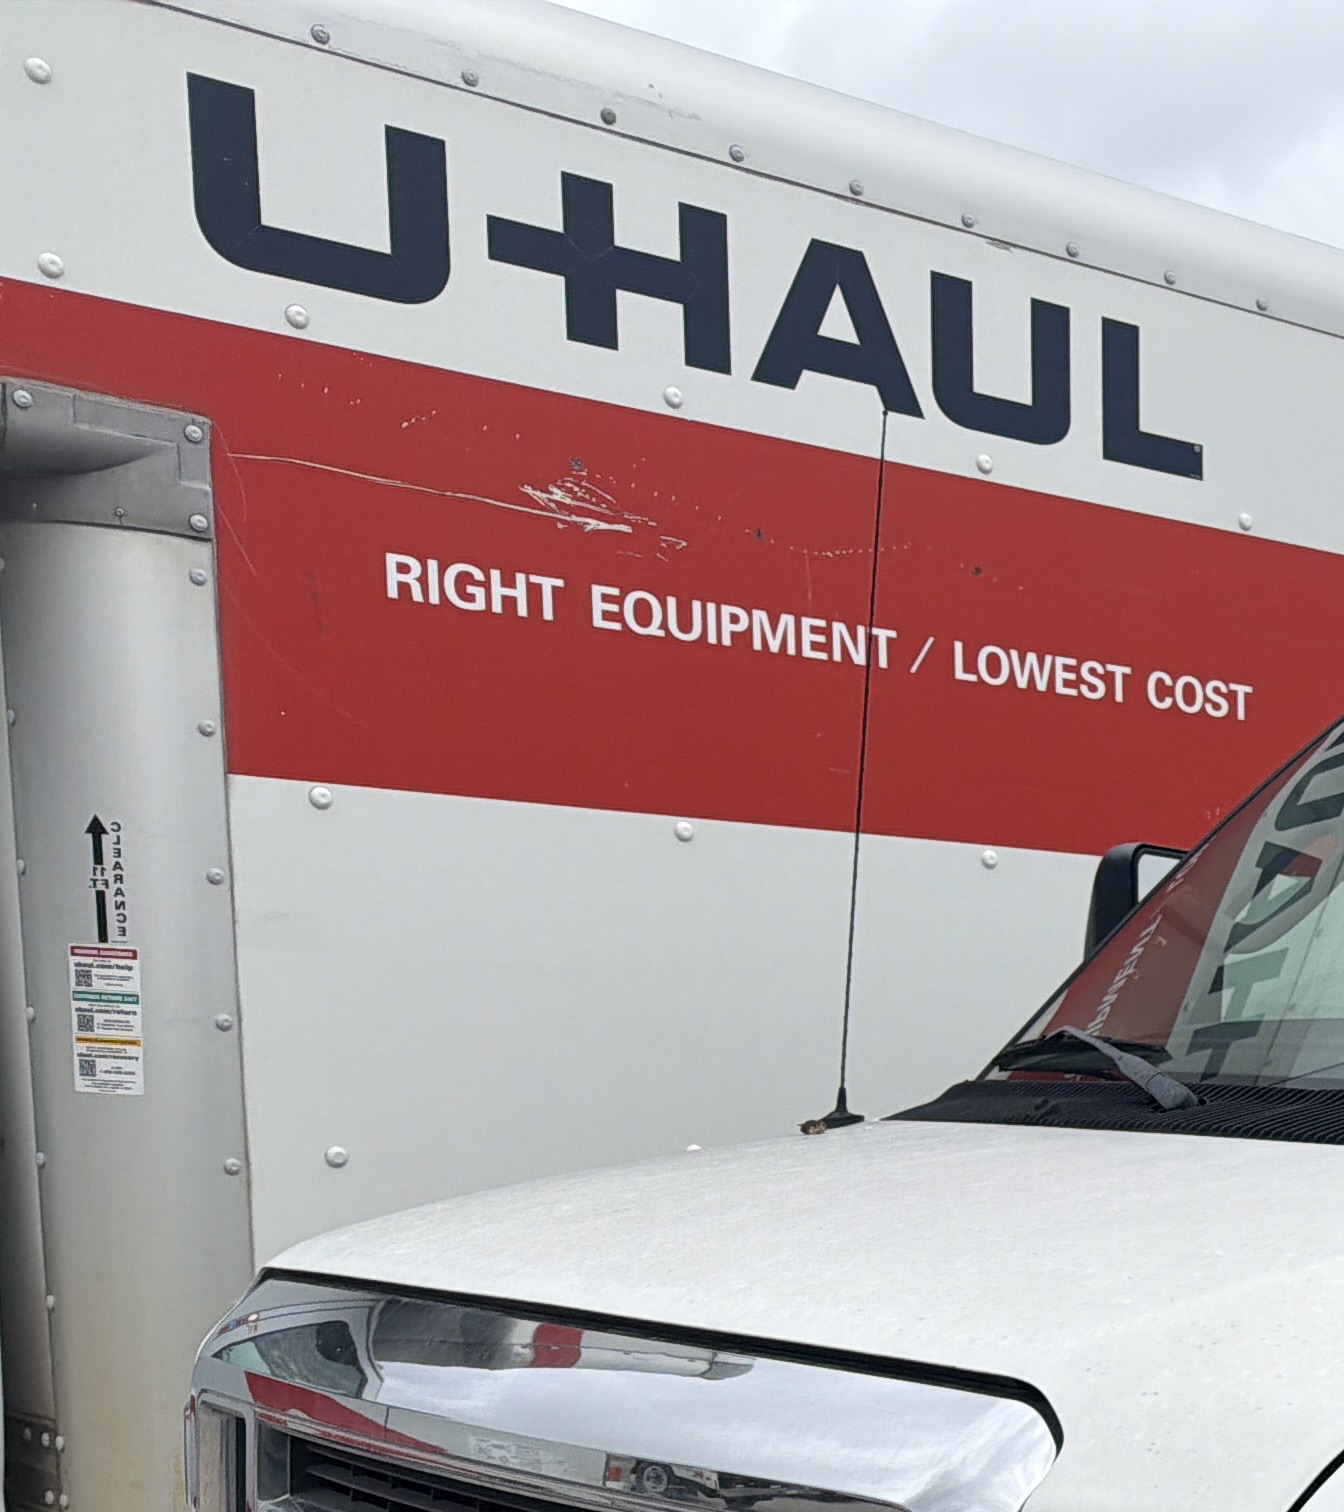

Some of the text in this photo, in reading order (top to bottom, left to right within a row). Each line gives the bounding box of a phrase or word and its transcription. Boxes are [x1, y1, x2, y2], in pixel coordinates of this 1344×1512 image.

[384, 552, 565, 622] RIGHT
[590, 583, 898, 669] EQUIPMENT
[952, 639, 1132, 703] LOWEST
[1146, 670, 1254, 721] COST
